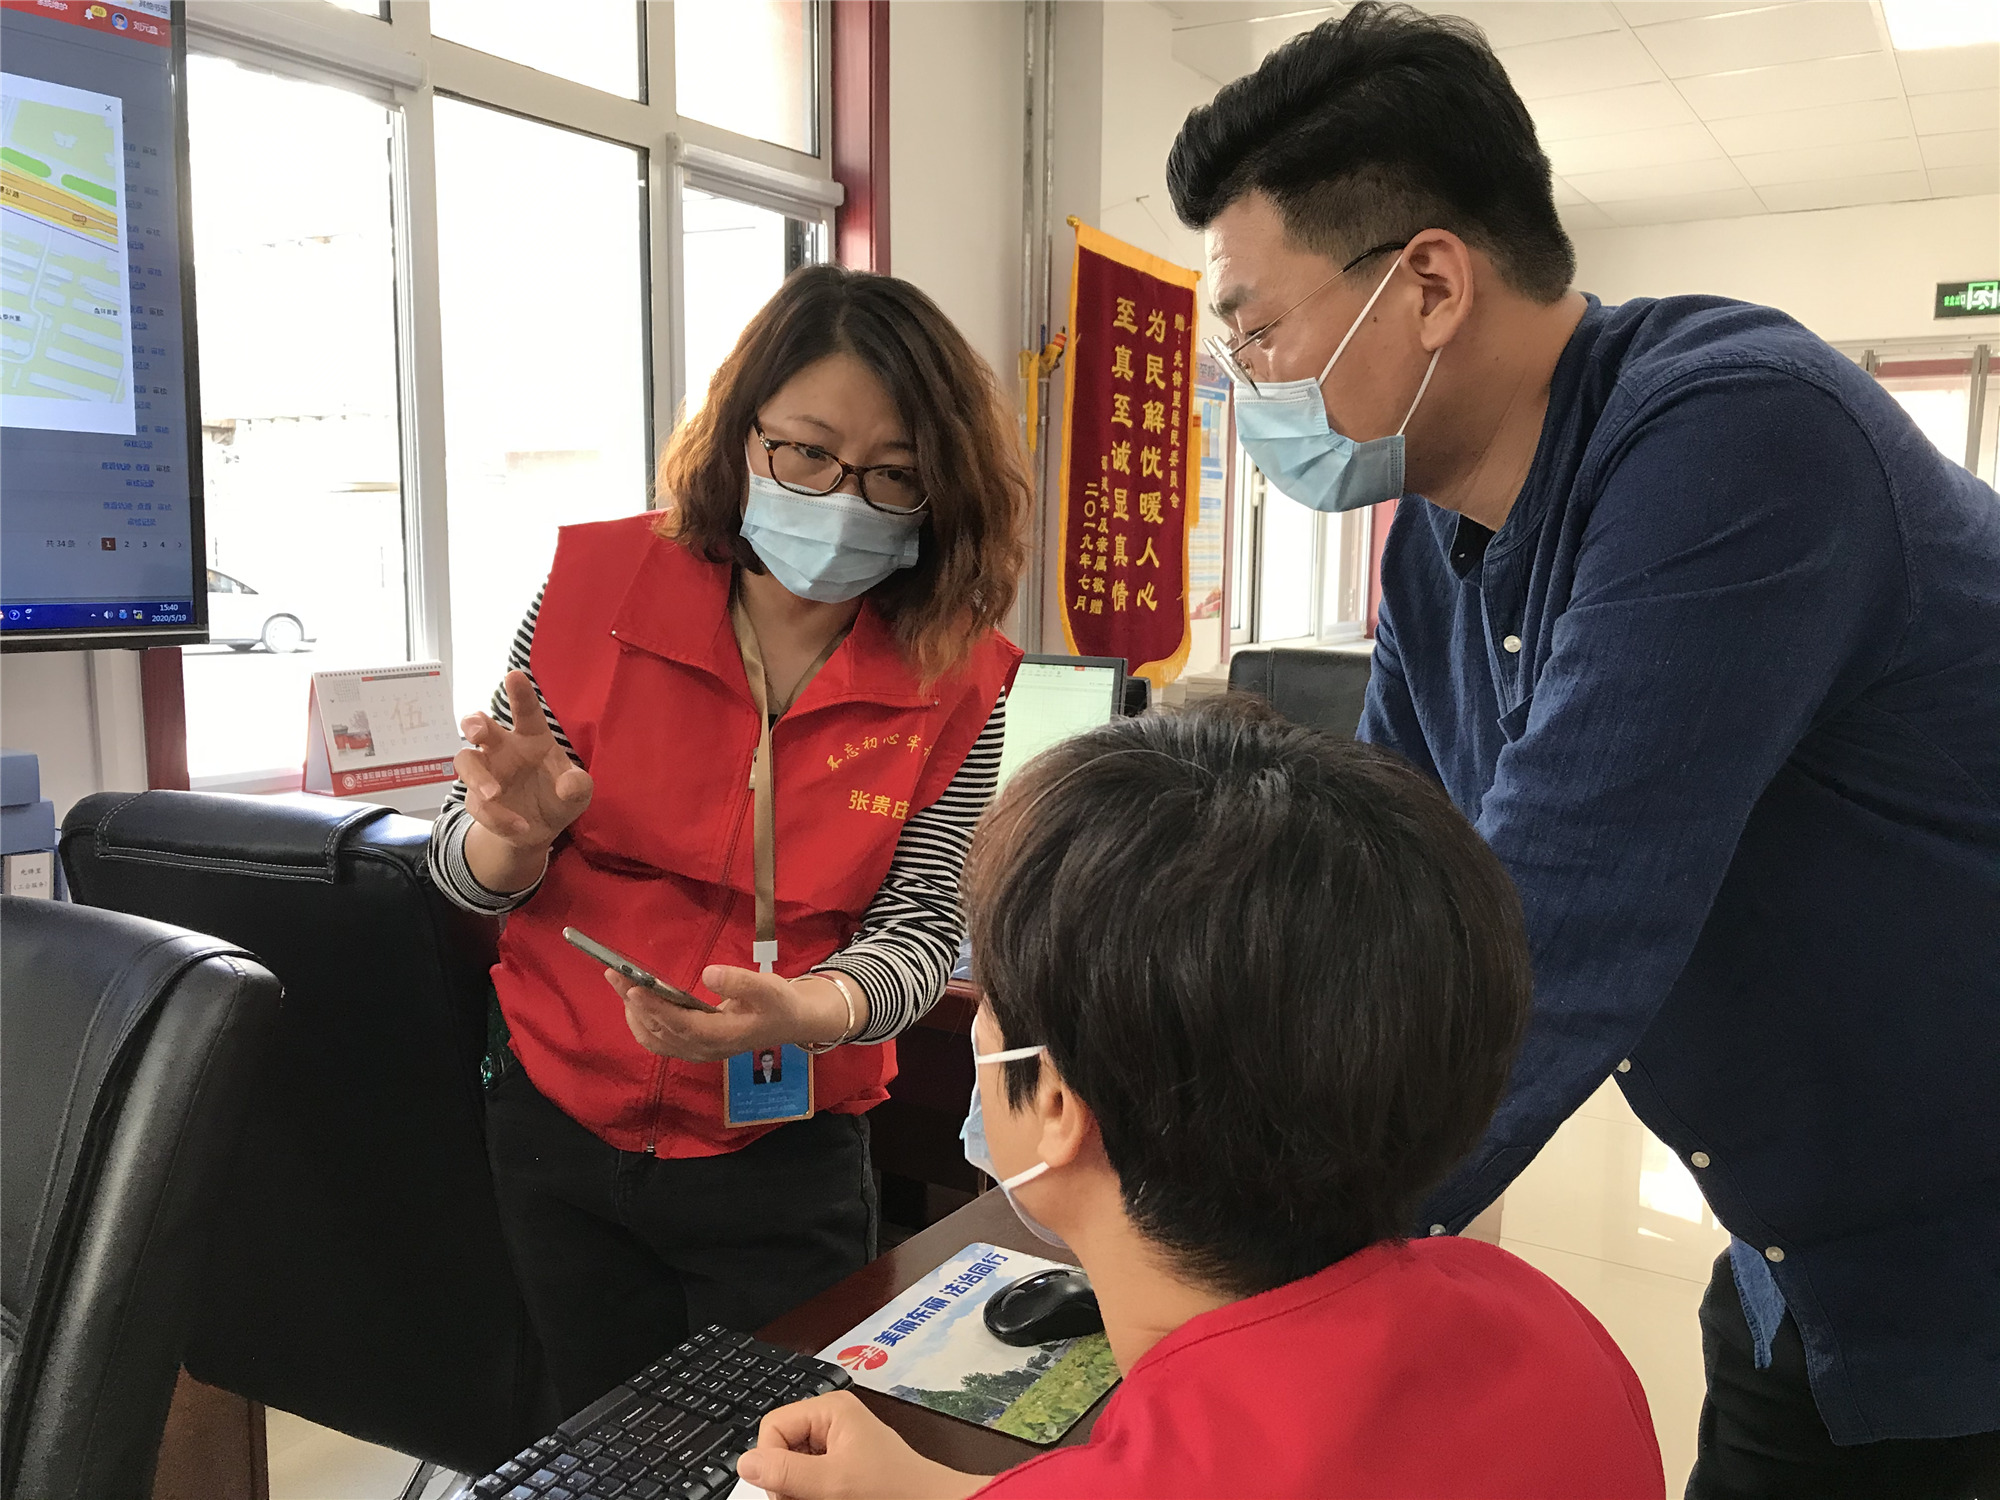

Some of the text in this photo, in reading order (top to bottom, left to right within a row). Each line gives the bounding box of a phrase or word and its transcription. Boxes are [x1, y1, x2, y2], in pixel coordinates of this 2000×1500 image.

[1110, 297, 1139, 612] 至真至诚显真情
[1136, 309, 1166, 612] 为民解忧暖人心
[56, 540, 66, 548] 34
[151, 614, 187, 623] 2020/5/19
[159, 603, 179, 612] 15:40
[848, 789, 910, 820] 张贵庄
[873, 1252, 1009, 1347] 美丽东丽 法治同行
